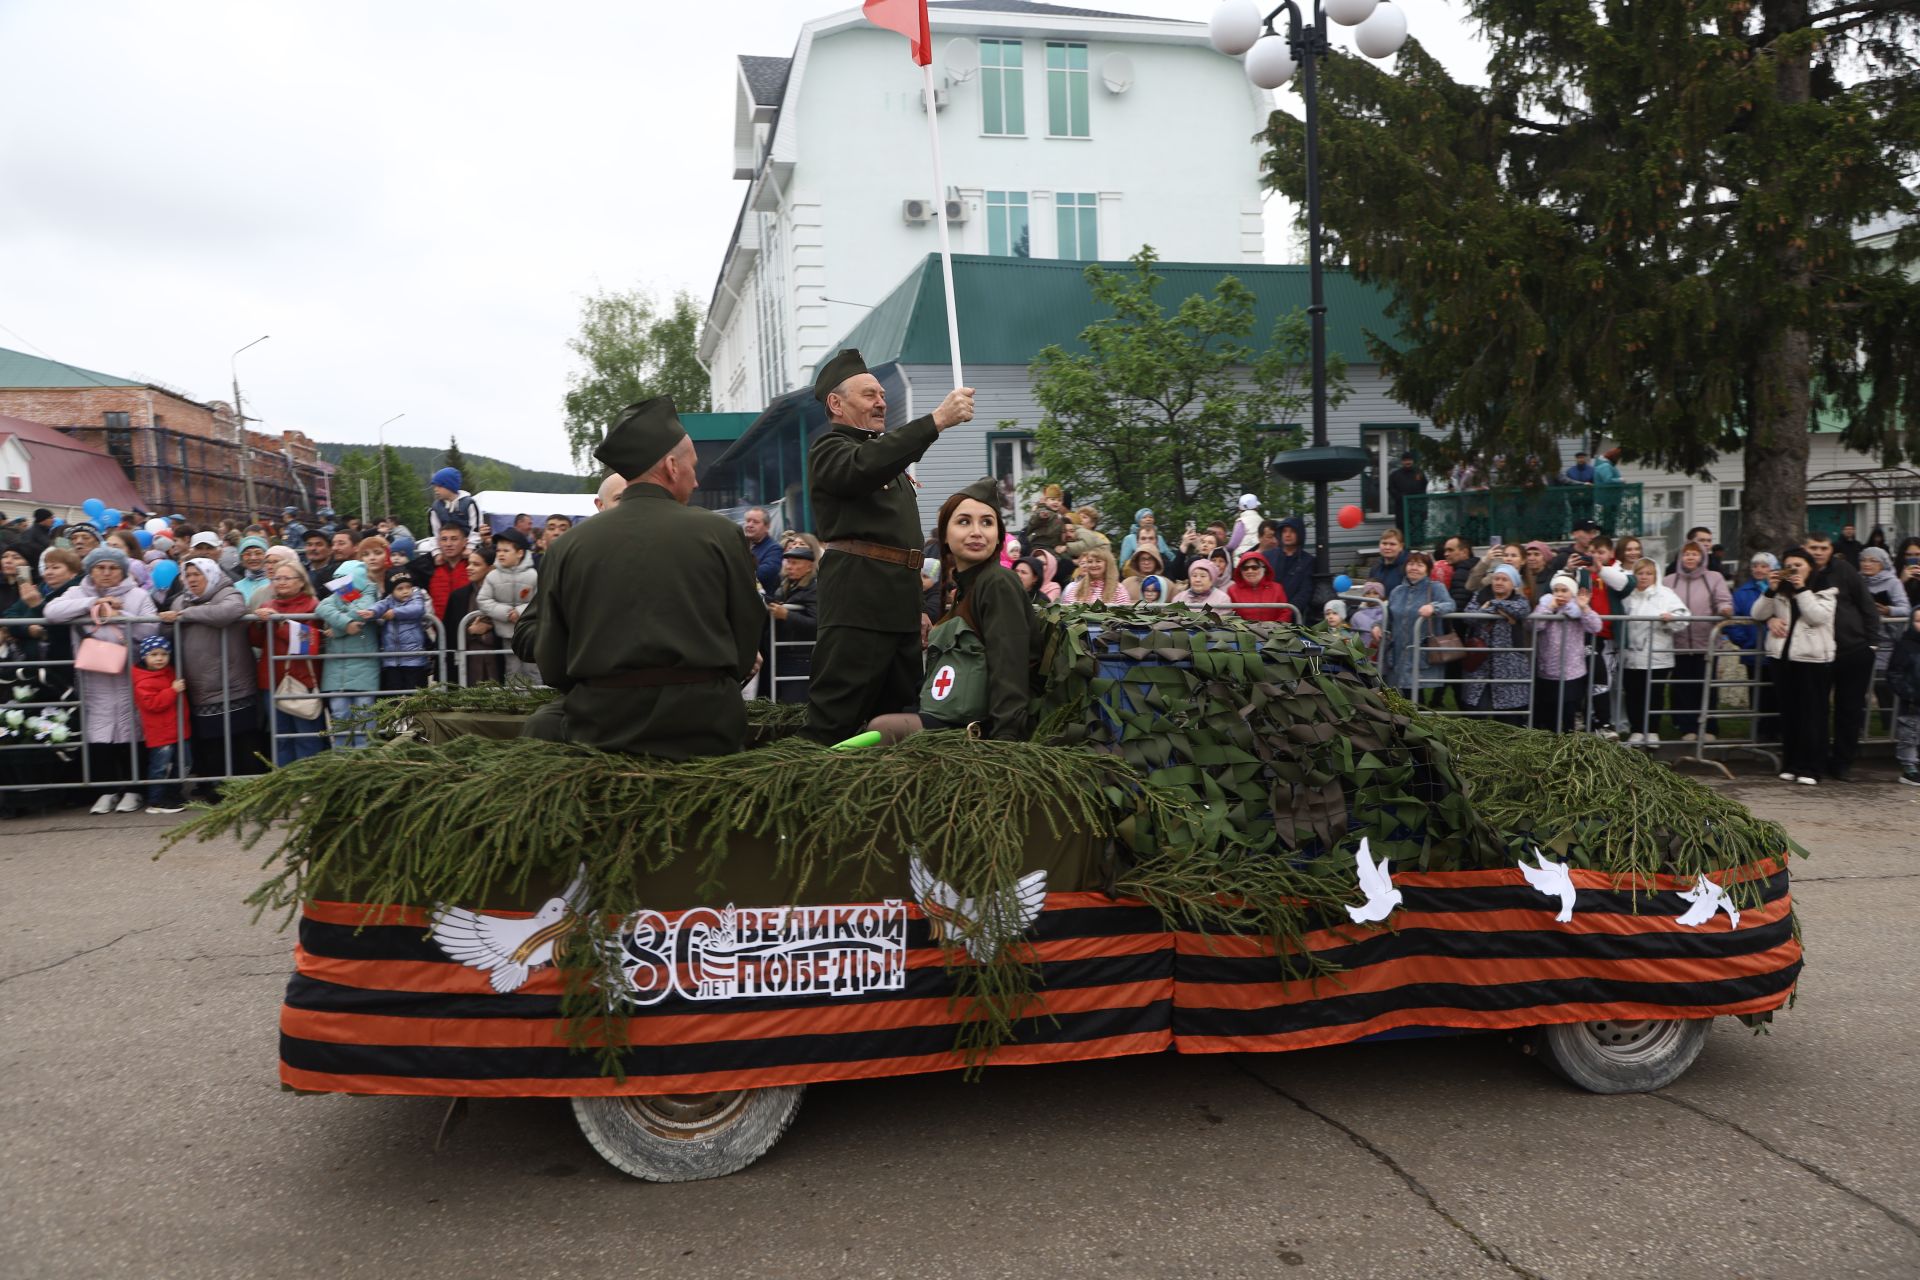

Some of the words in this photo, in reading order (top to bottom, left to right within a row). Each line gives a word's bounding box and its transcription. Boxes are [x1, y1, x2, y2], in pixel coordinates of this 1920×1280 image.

[736, 900, 904, 944] ВЕЛИКОЙ
[618, 907, 725, 1005] 80
[700, 980, 730, 997] ЛЕТ
